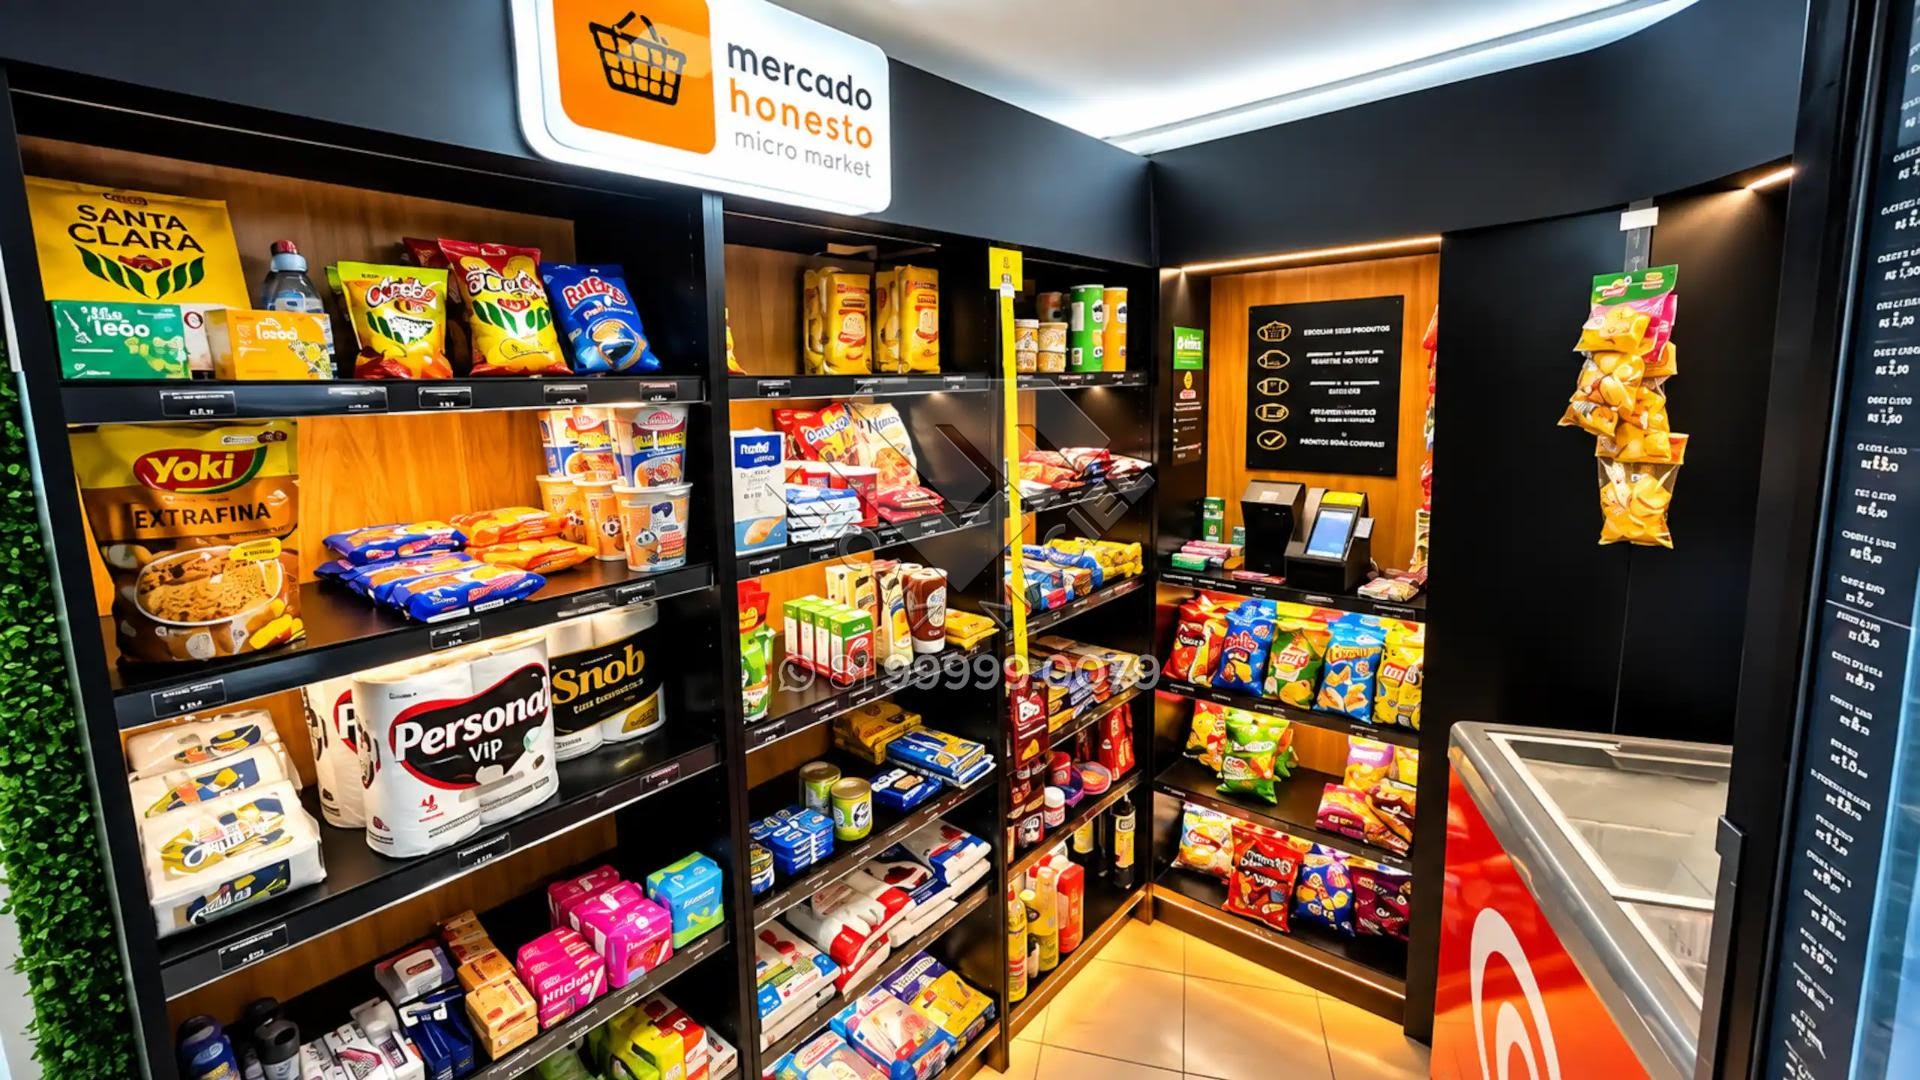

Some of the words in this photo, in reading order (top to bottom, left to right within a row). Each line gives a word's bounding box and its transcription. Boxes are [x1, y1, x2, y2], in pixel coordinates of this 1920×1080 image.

[727, 41, 873, 111] mercado
[729, 78, 874, 149] honesto
[735, 129, 797, 161] micro
[805, 147, 872, 179] market
[68, 222, 204, 253] CLARA
[77, 204, 188, 231] SANTA
[146, 453, 235, 484] Yoki
[134, 503, 271, 529] EXTRAFINA
[552, 644, 646, 705] Snob
[395, 675, 550, 763] Personal
